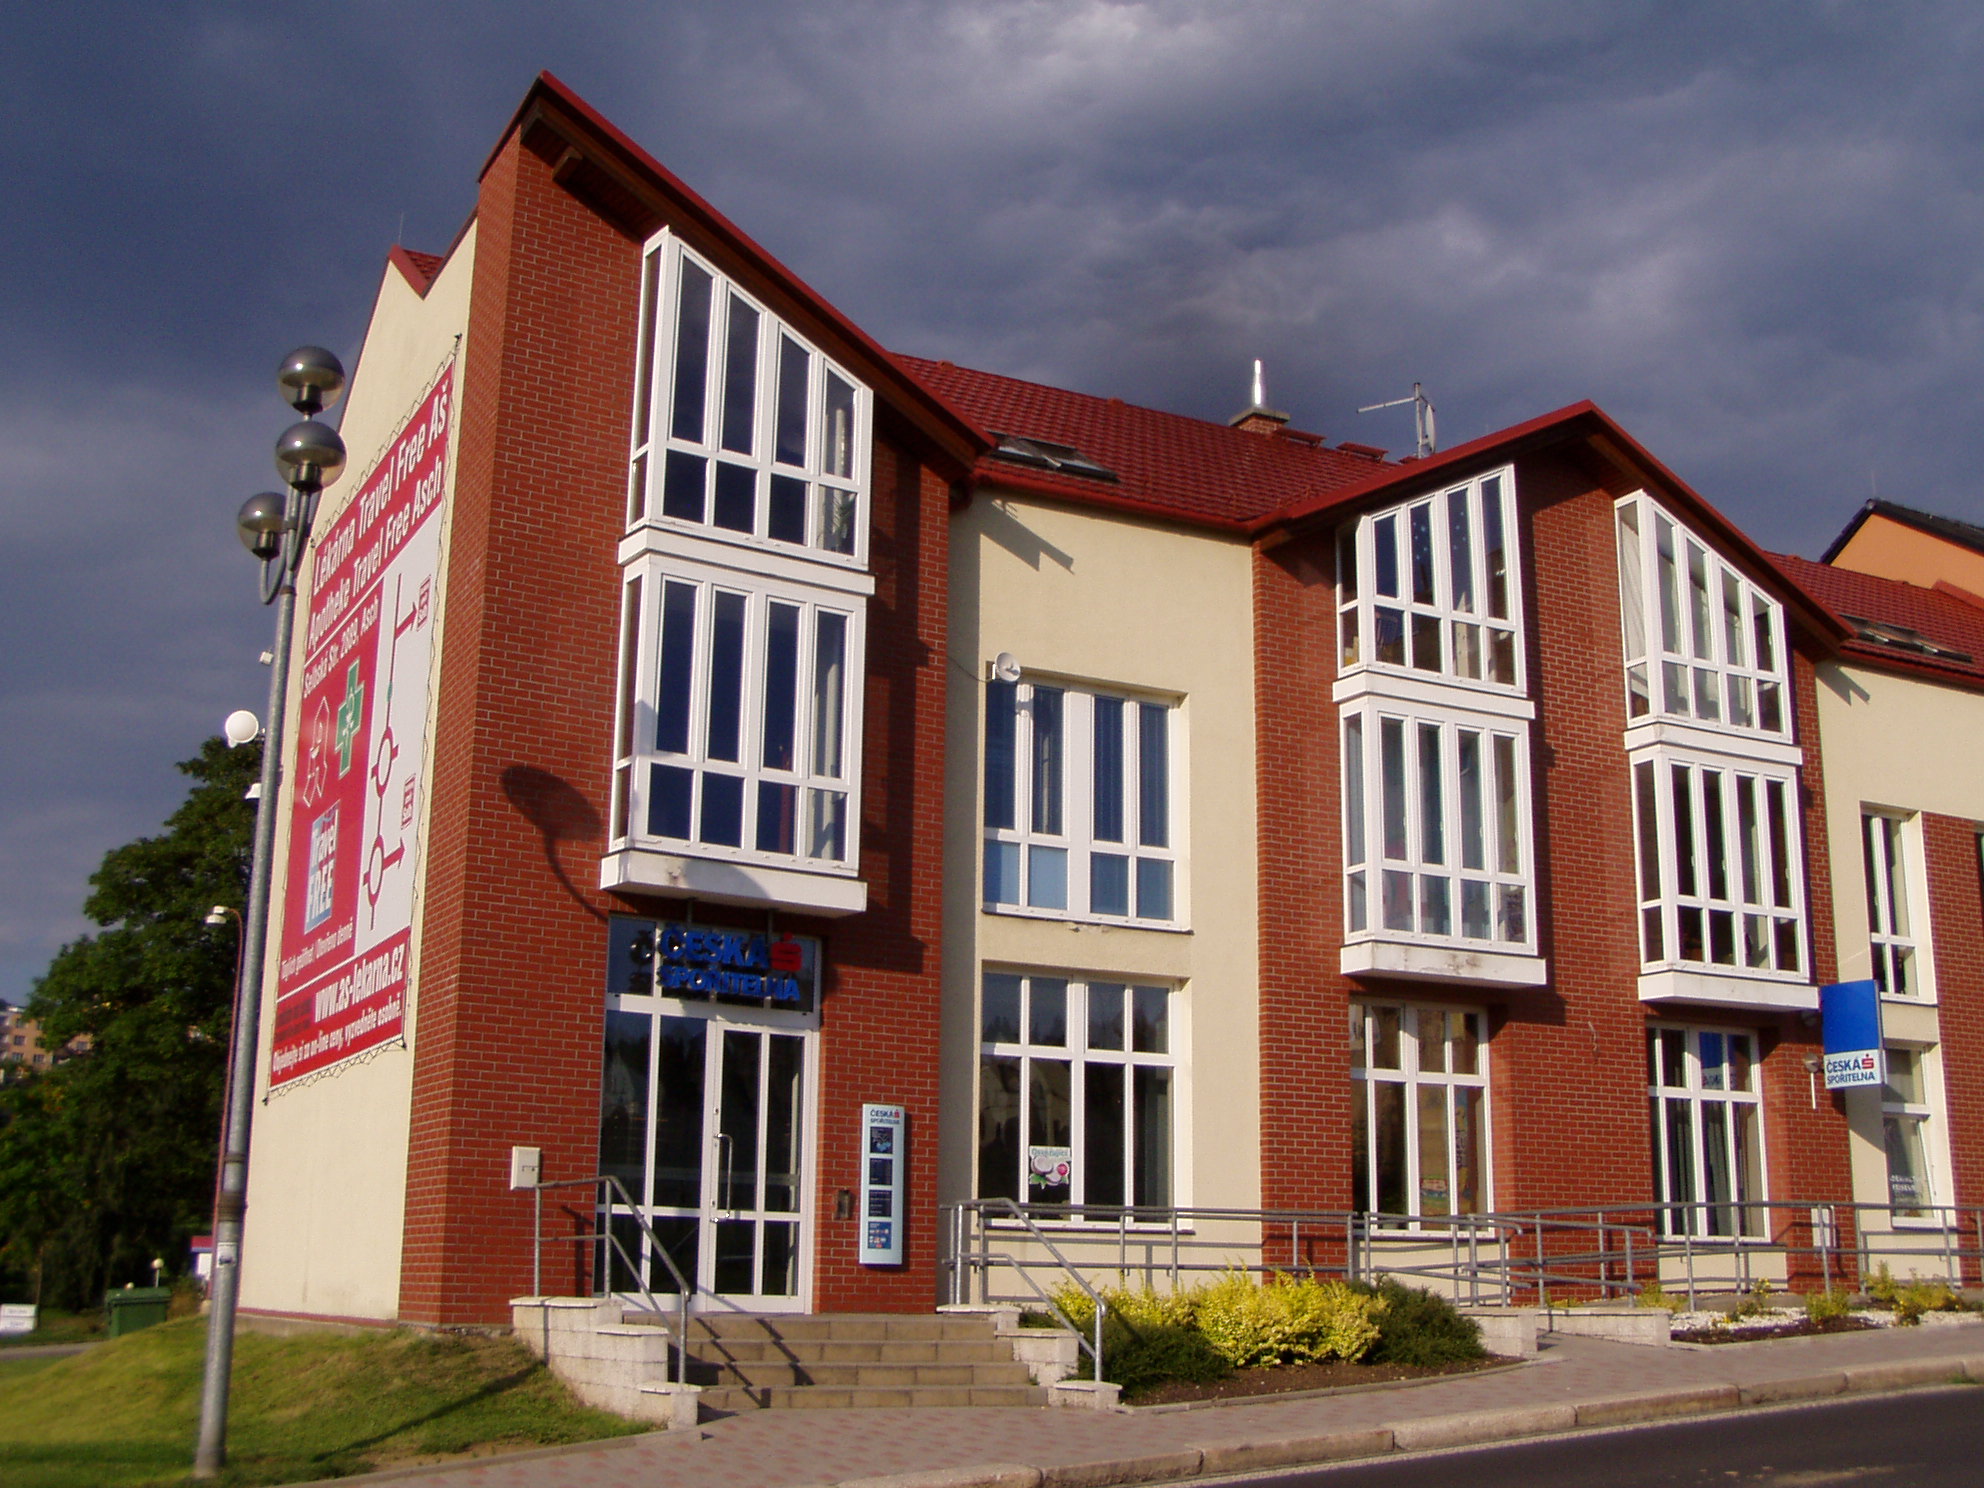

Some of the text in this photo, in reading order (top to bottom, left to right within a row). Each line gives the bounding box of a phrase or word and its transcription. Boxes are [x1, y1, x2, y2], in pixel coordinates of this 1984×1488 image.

[313, 378, 450, 597] Lékárna Travel Free Aš
[352, 526, 385, 598] Travel
[384, 502, 411, 559] Free
[411, 454, 443, 527] Asch
[309, 807, 340, 870] Travel
[303, 856, 335, 924] FREE
[314, 942, 405, 1024] www.as-lekarna.cz
[658, 963, 801, 1002] SPOŘITELNA
[1826, 1056, 1861, 1074] ČESKÁ
[1827, 1071, 1876, 1085] SPOŘITELNA
